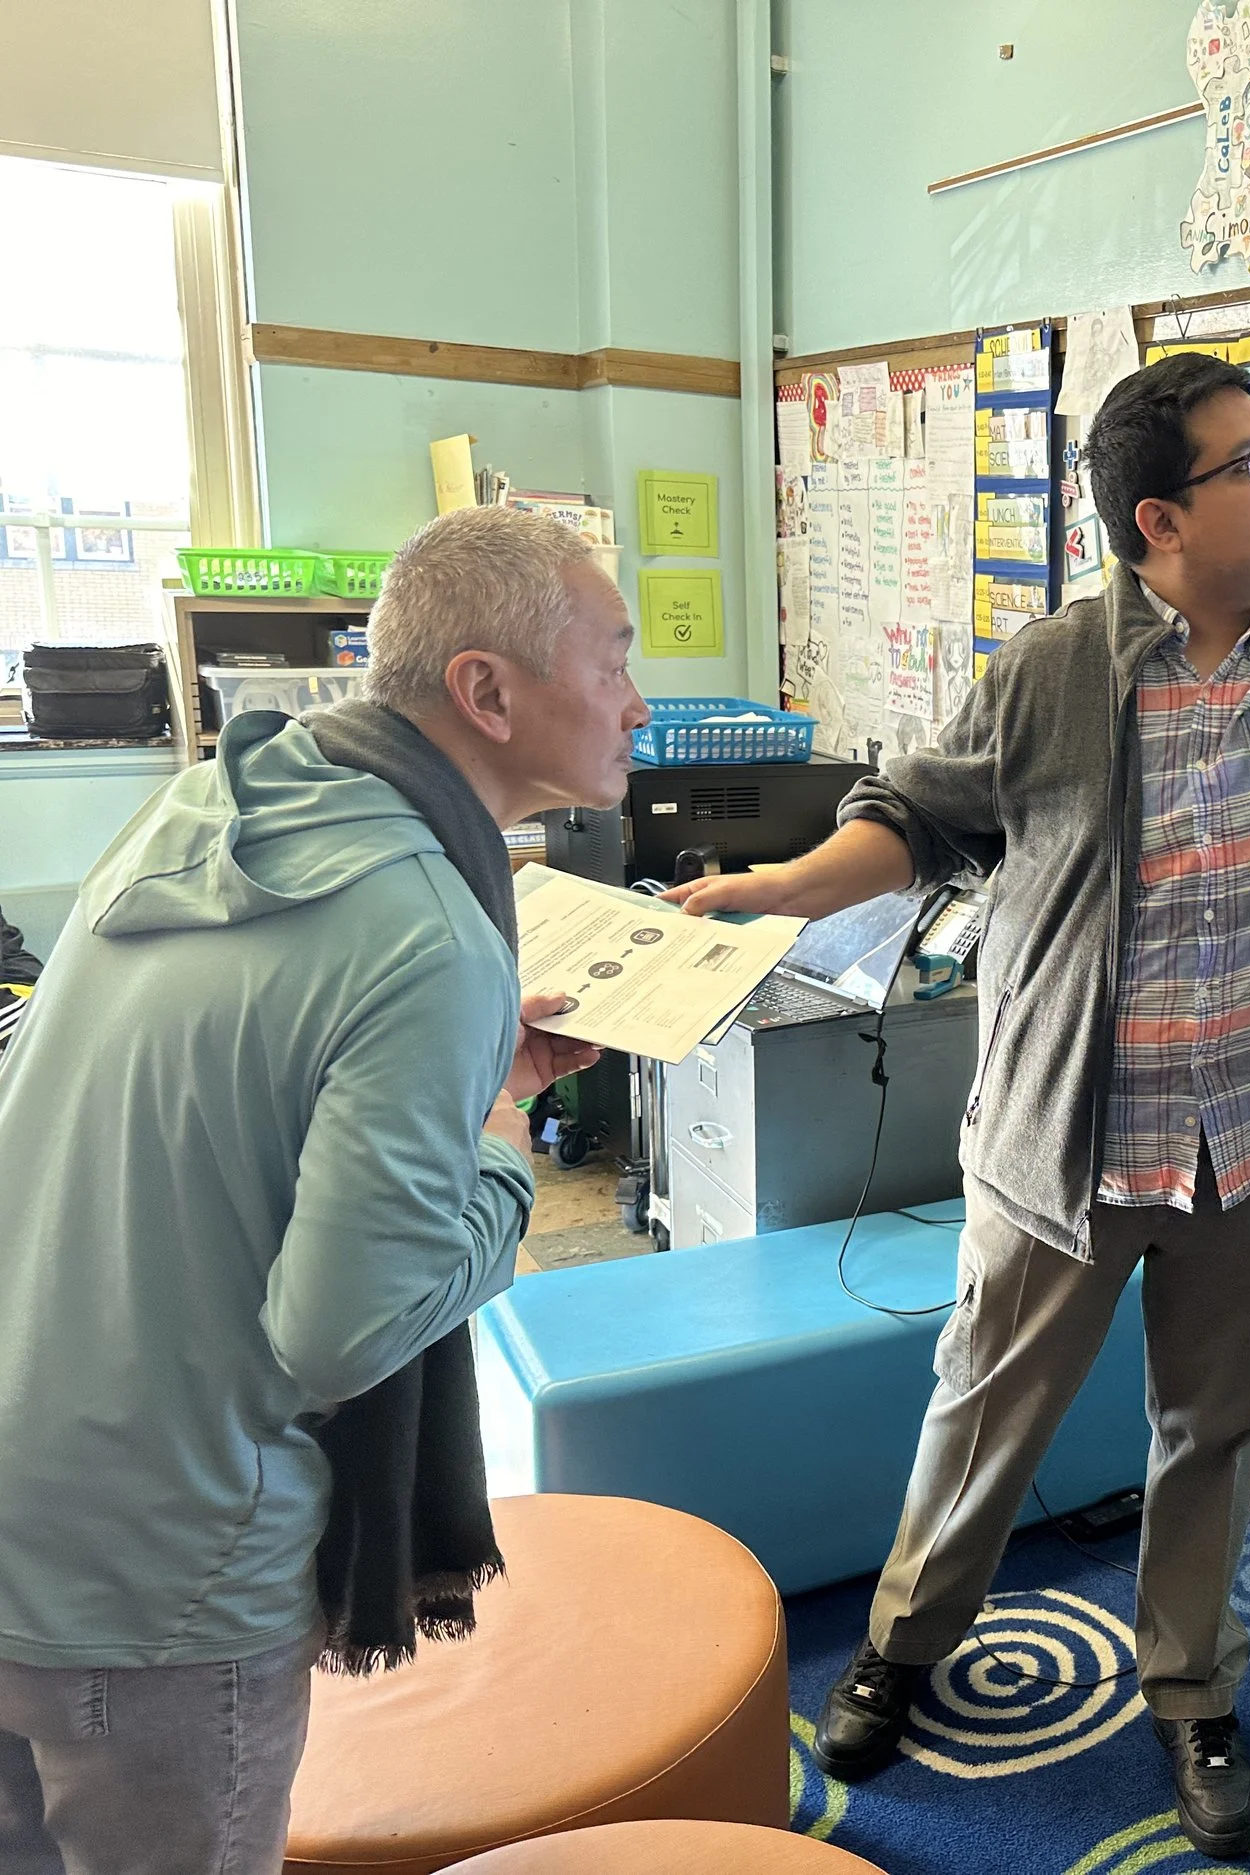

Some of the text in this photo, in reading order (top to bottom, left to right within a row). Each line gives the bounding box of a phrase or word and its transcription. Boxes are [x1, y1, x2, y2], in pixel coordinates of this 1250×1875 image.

[940, 384, 960, 401] YOU
[657, 493, 695, 505] Mastery
[662, 505, 691, 515] Check
[238, 571, 263, 583] 235
[672, 601, 690, 610] Self
[661, 612, 691, 621] Check
